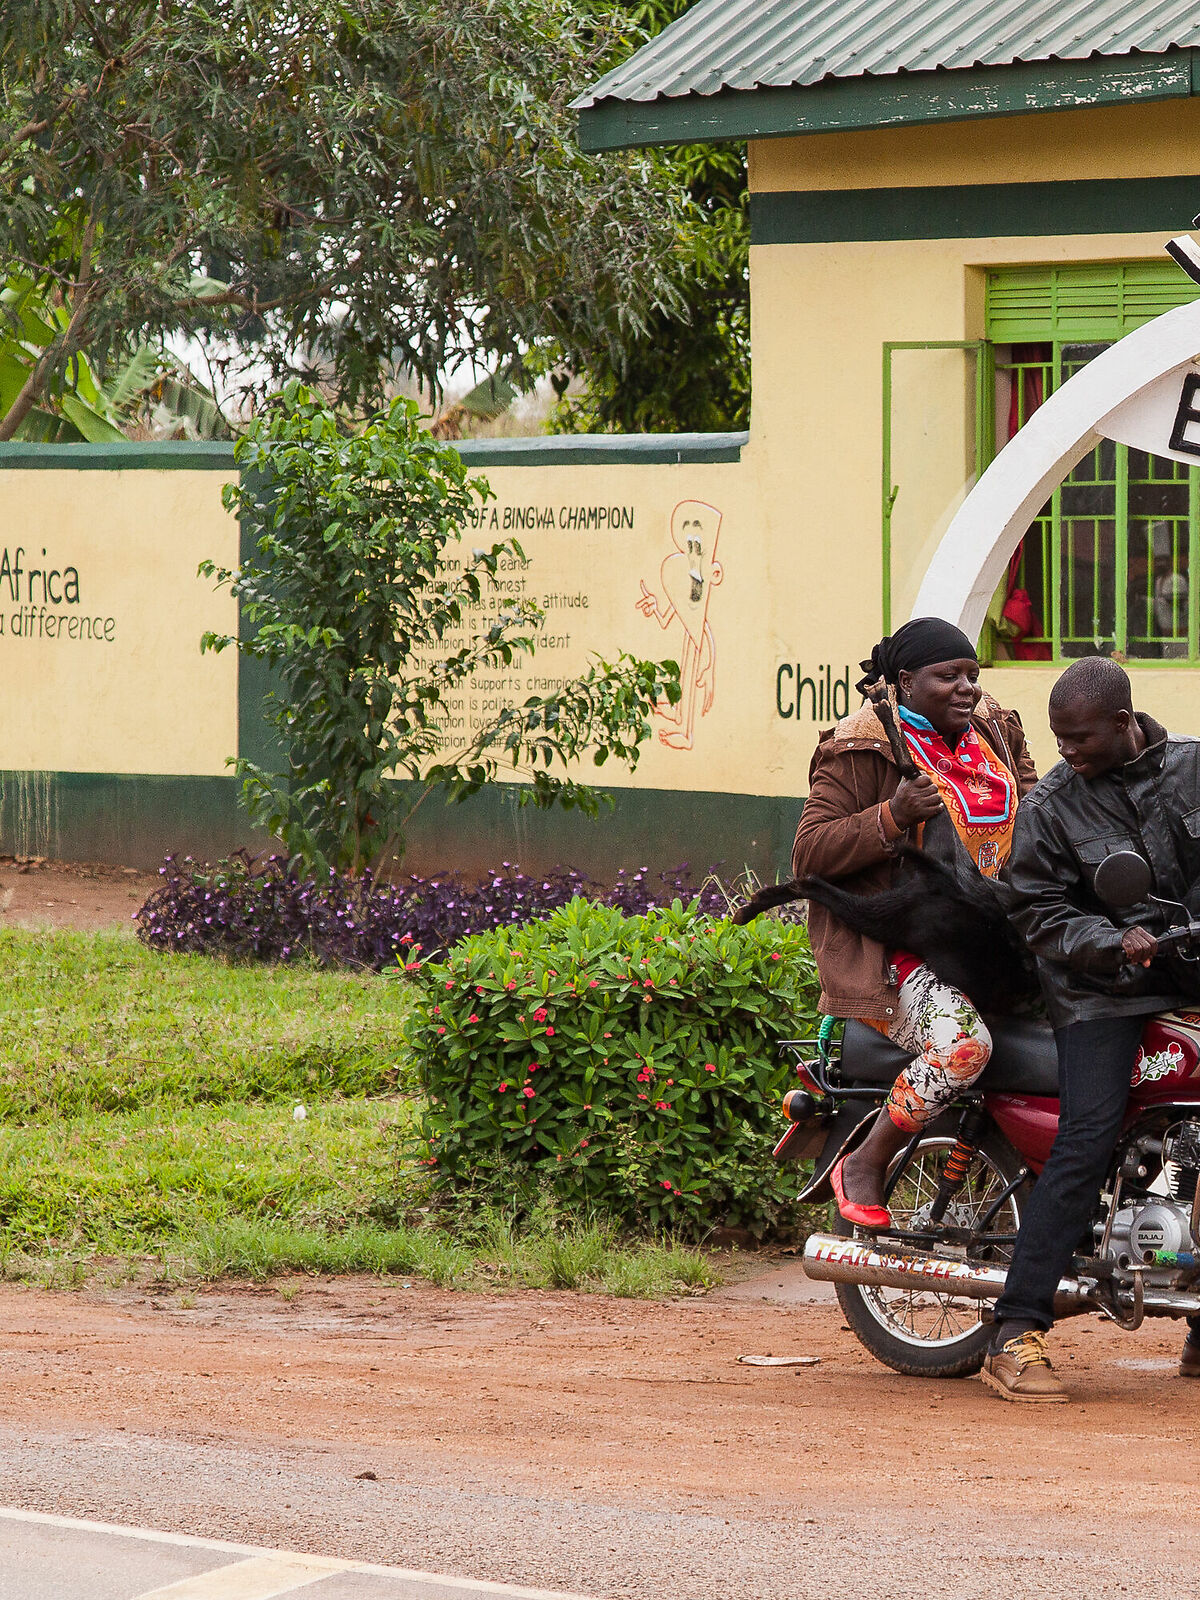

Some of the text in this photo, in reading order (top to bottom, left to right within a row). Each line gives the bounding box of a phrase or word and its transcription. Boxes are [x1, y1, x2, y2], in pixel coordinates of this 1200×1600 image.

[471, 506, 635, 530] OF A BINGWA CHAMPION
[0, 547, 80, 604] Africa
[486, 575, 526, 593] honest
[542, 592, 588, 608] attitude
[10, 605, 116, 642] difference
[469, 696, 478, 710] is
[482, 696, 515, 715] polite
[815, 1241, 874, 1267] TEAM
